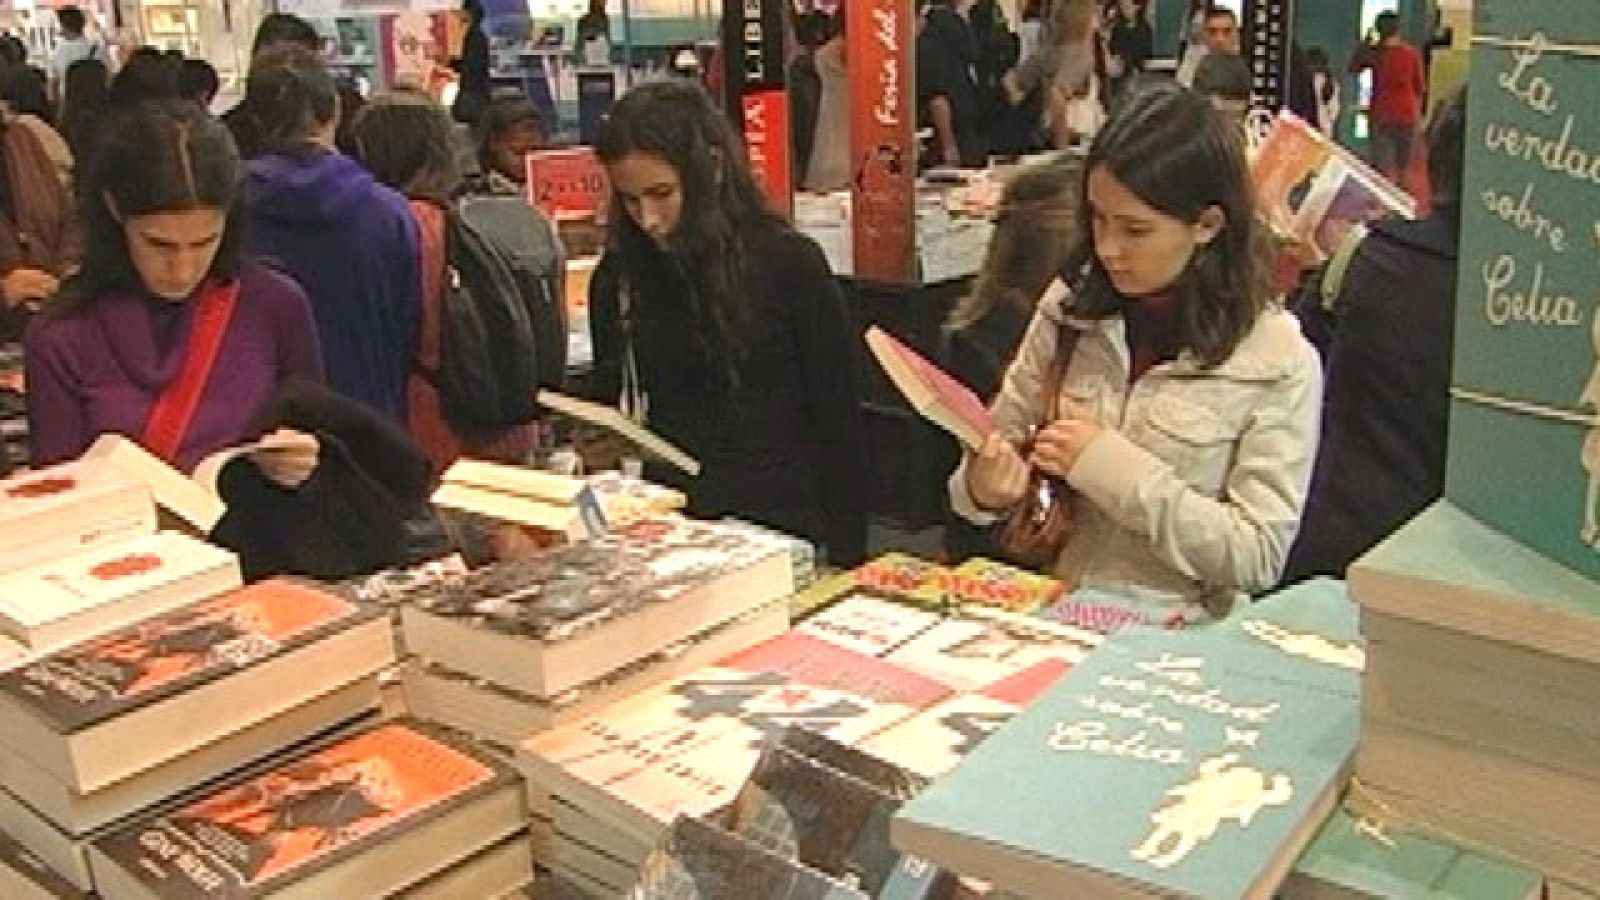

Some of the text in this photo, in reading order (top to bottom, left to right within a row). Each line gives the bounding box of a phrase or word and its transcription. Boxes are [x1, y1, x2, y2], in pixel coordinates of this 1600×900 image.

[1498, 31, 1556, 116] La
[1480, 182, 1566, 252] sobre
[1482, 253, 1582, 327] Celia
